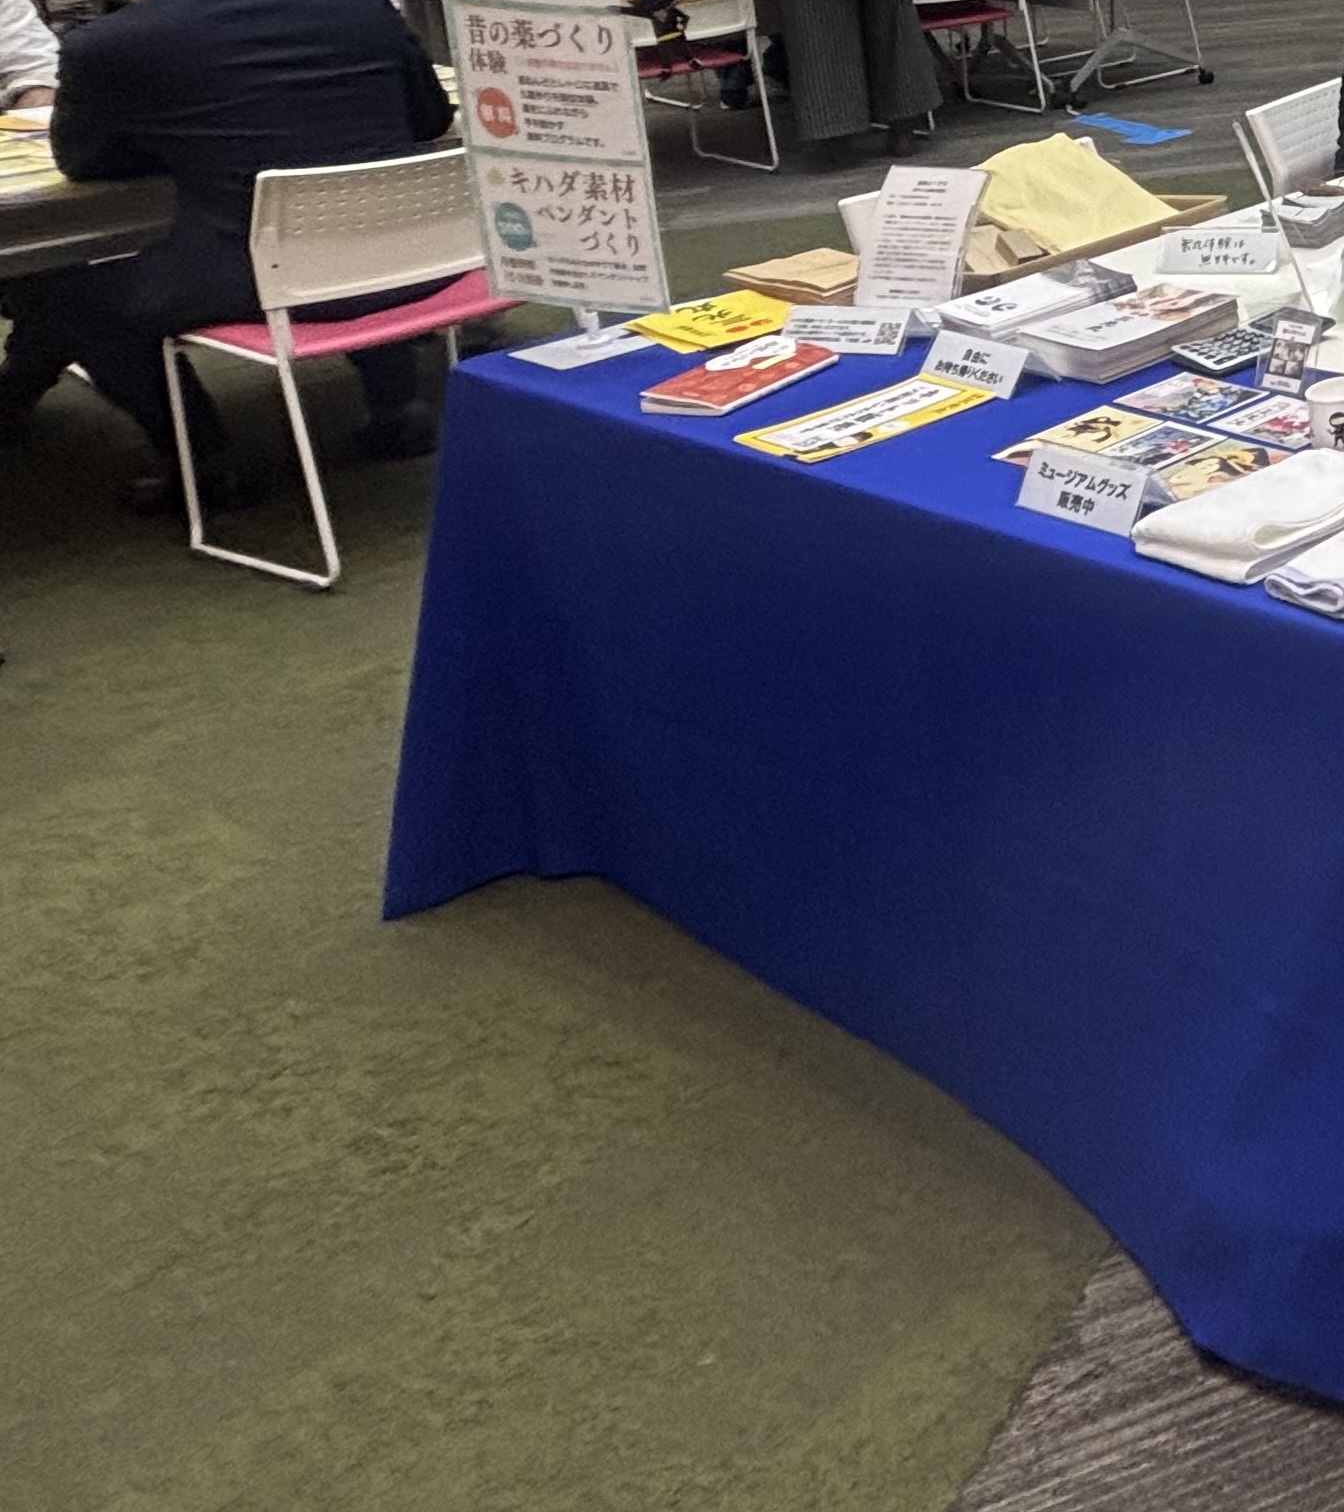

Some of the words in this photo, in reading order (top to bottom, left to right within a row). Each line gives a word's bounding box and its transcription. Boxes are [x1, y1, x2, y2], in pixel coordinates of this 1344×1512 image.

[465, 14, 613, 55] 昔の薬づくり
[468, 48, 508, 74] 体験
[511, 170, 635, 203] キハダ素材
[537, 204, 637, 230] ペンダント
[580, 231, 639, 257] づくり
[1038, 461, 1133, 500] ミュージアムグッズ
[1056, 490, 1096, 516] 販売中
